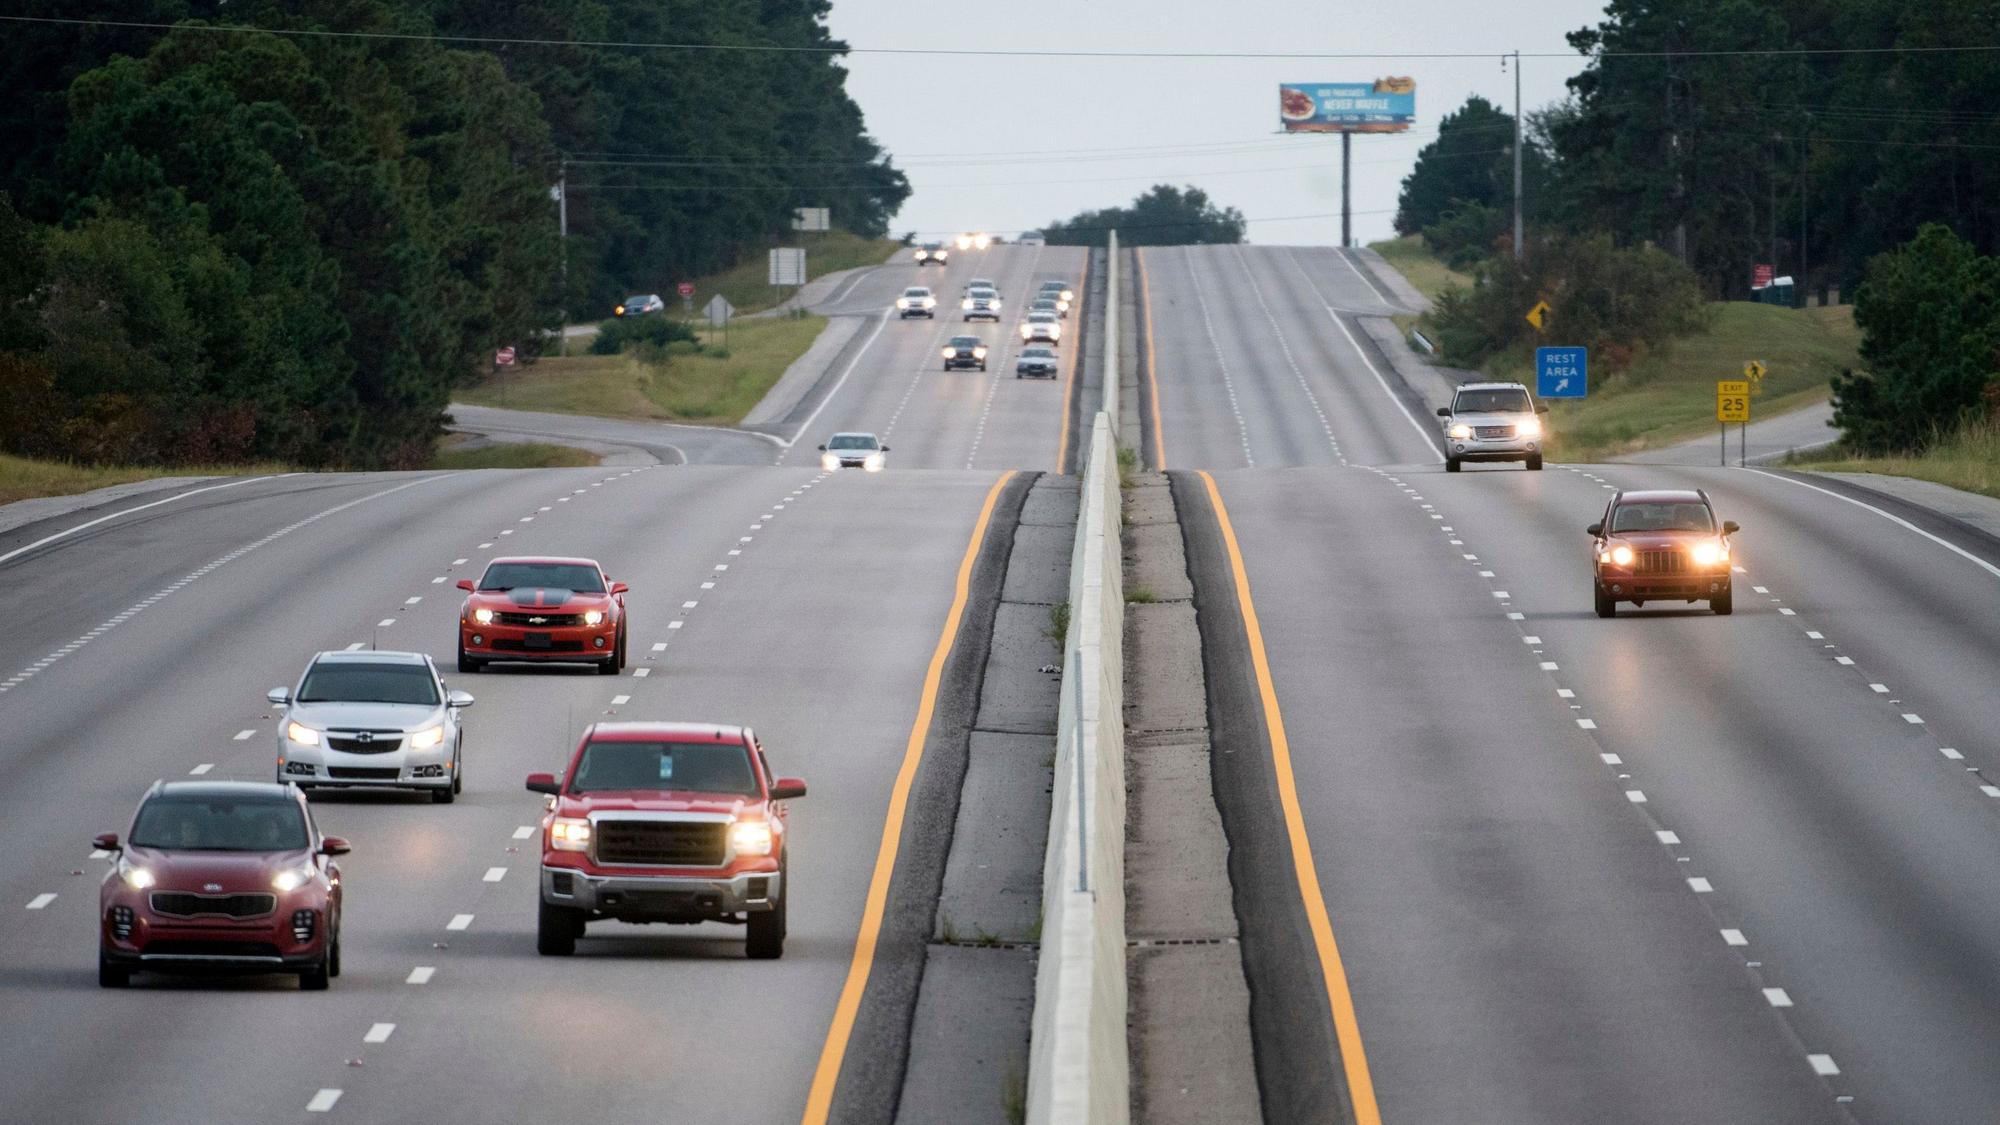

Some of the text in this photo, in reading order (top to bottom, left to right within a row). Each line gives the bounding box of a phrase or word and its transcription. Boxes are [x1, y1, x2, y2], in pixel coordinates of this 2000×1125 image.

[1324, 99, 1389, 110] NEVER WAFFLE
[1546, 353, 1577, 363] REST
[1545, 366, 1578, 377] AREA
[1722, 398, 1745, 411] 25
